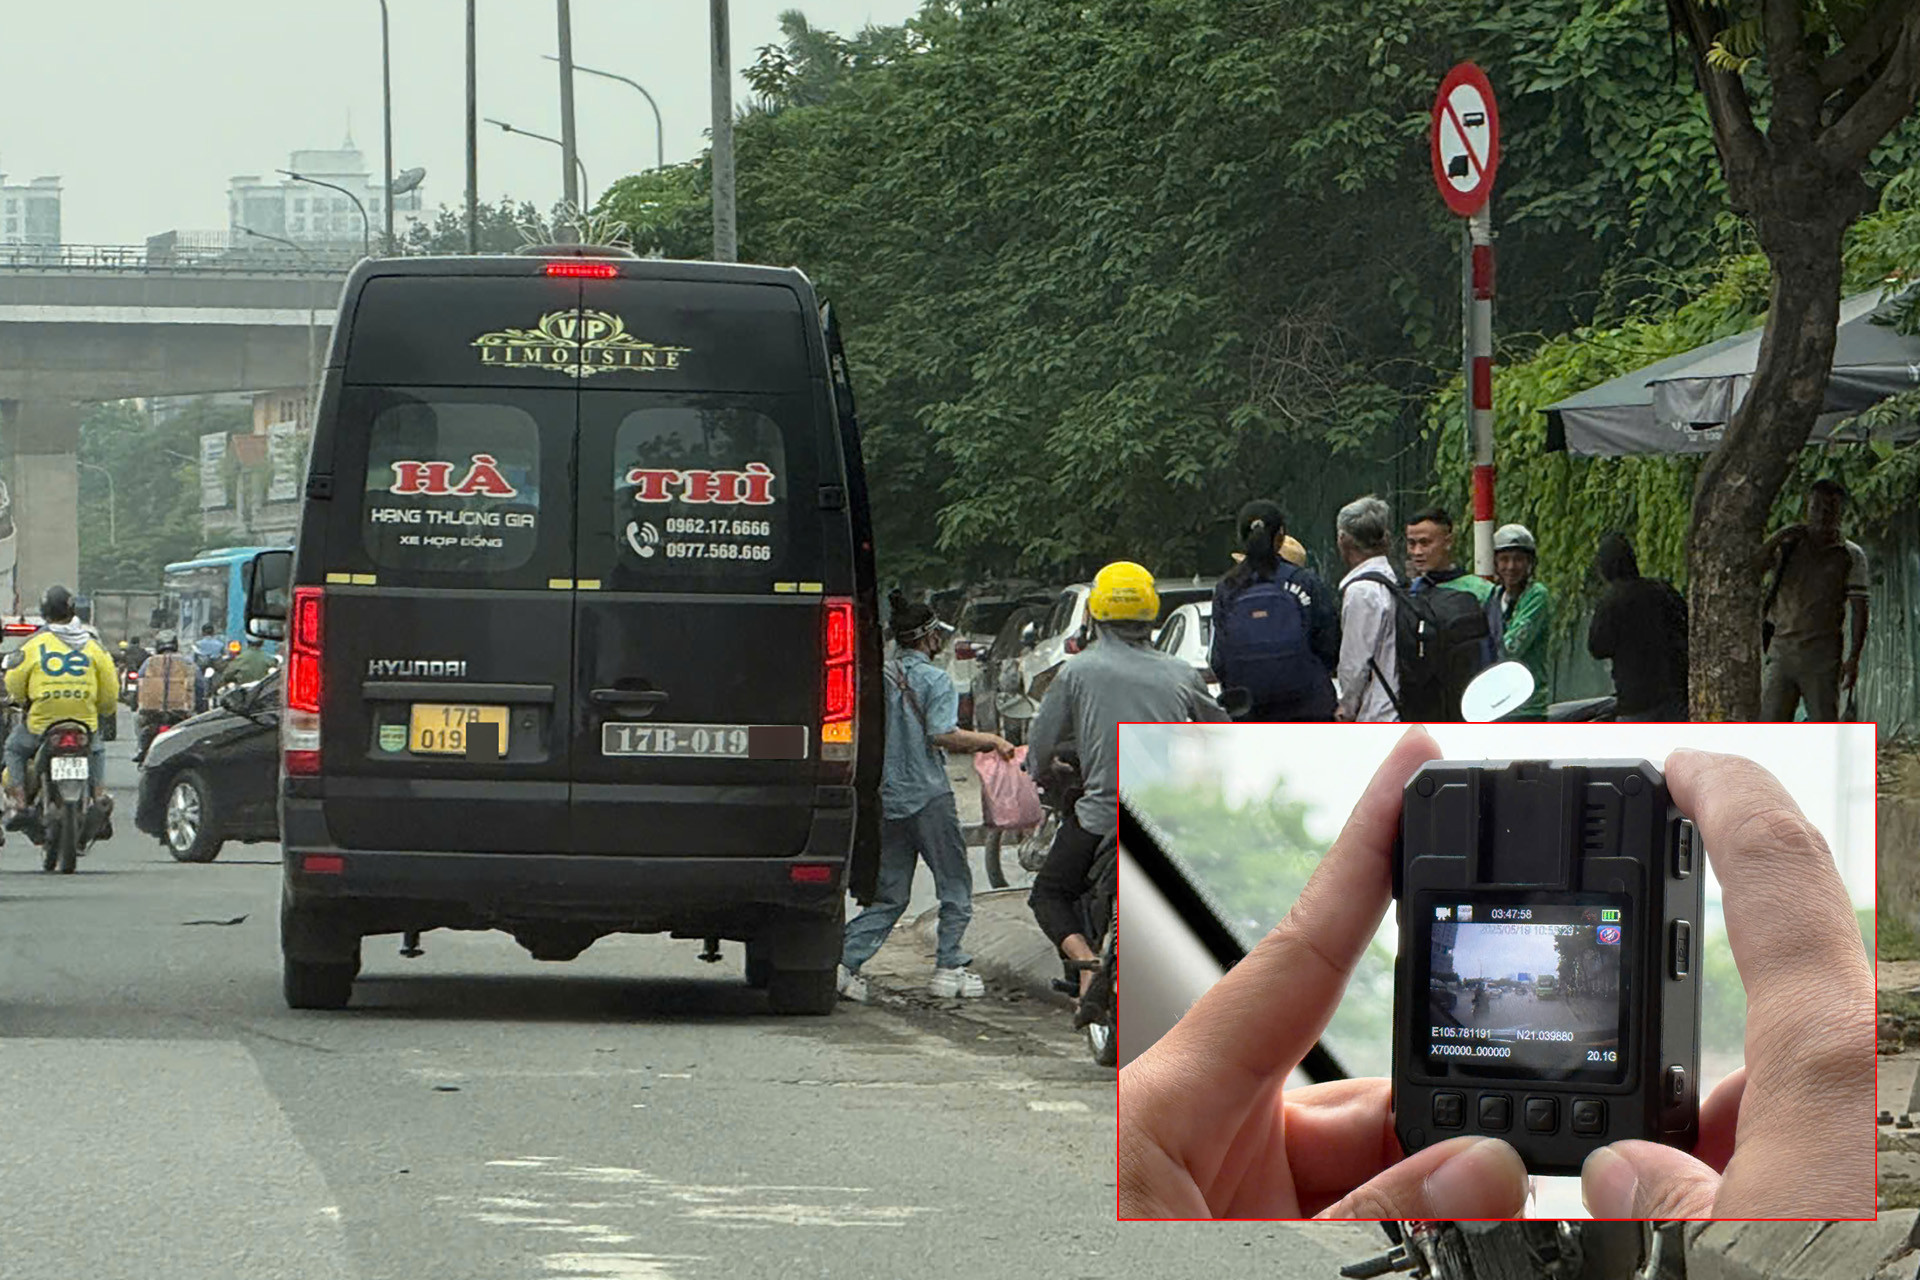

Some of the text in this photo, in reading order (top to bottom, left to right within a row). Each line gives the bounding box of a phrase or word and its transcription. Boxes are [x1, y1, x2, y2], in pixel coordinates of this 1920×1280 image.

[558, 319, 606, 340] VIP
[481, 346, 680, 367] LIMOUSINE
[390, 454, 775, 505] HÀ THÌ
[505, 513, 534, 528] GIA
[666, 518, 771, 536] 0962.17.6666
[399, 535, 420, 545] XE
[666, 543, 771, 561] 0977.568.666
[39, 643, 90, 677] be
[368, 659, 467, 676] HYUNDAI
[421, 728, 467, 749] 019.
[616, 727, 748, 753] 17B-019
[1491, 908, 1532, 919] 03:47:58
[1431, 1026, 1491, 1040] E105.781191
[1587, 1050, 1617, 1062] 20.1G
